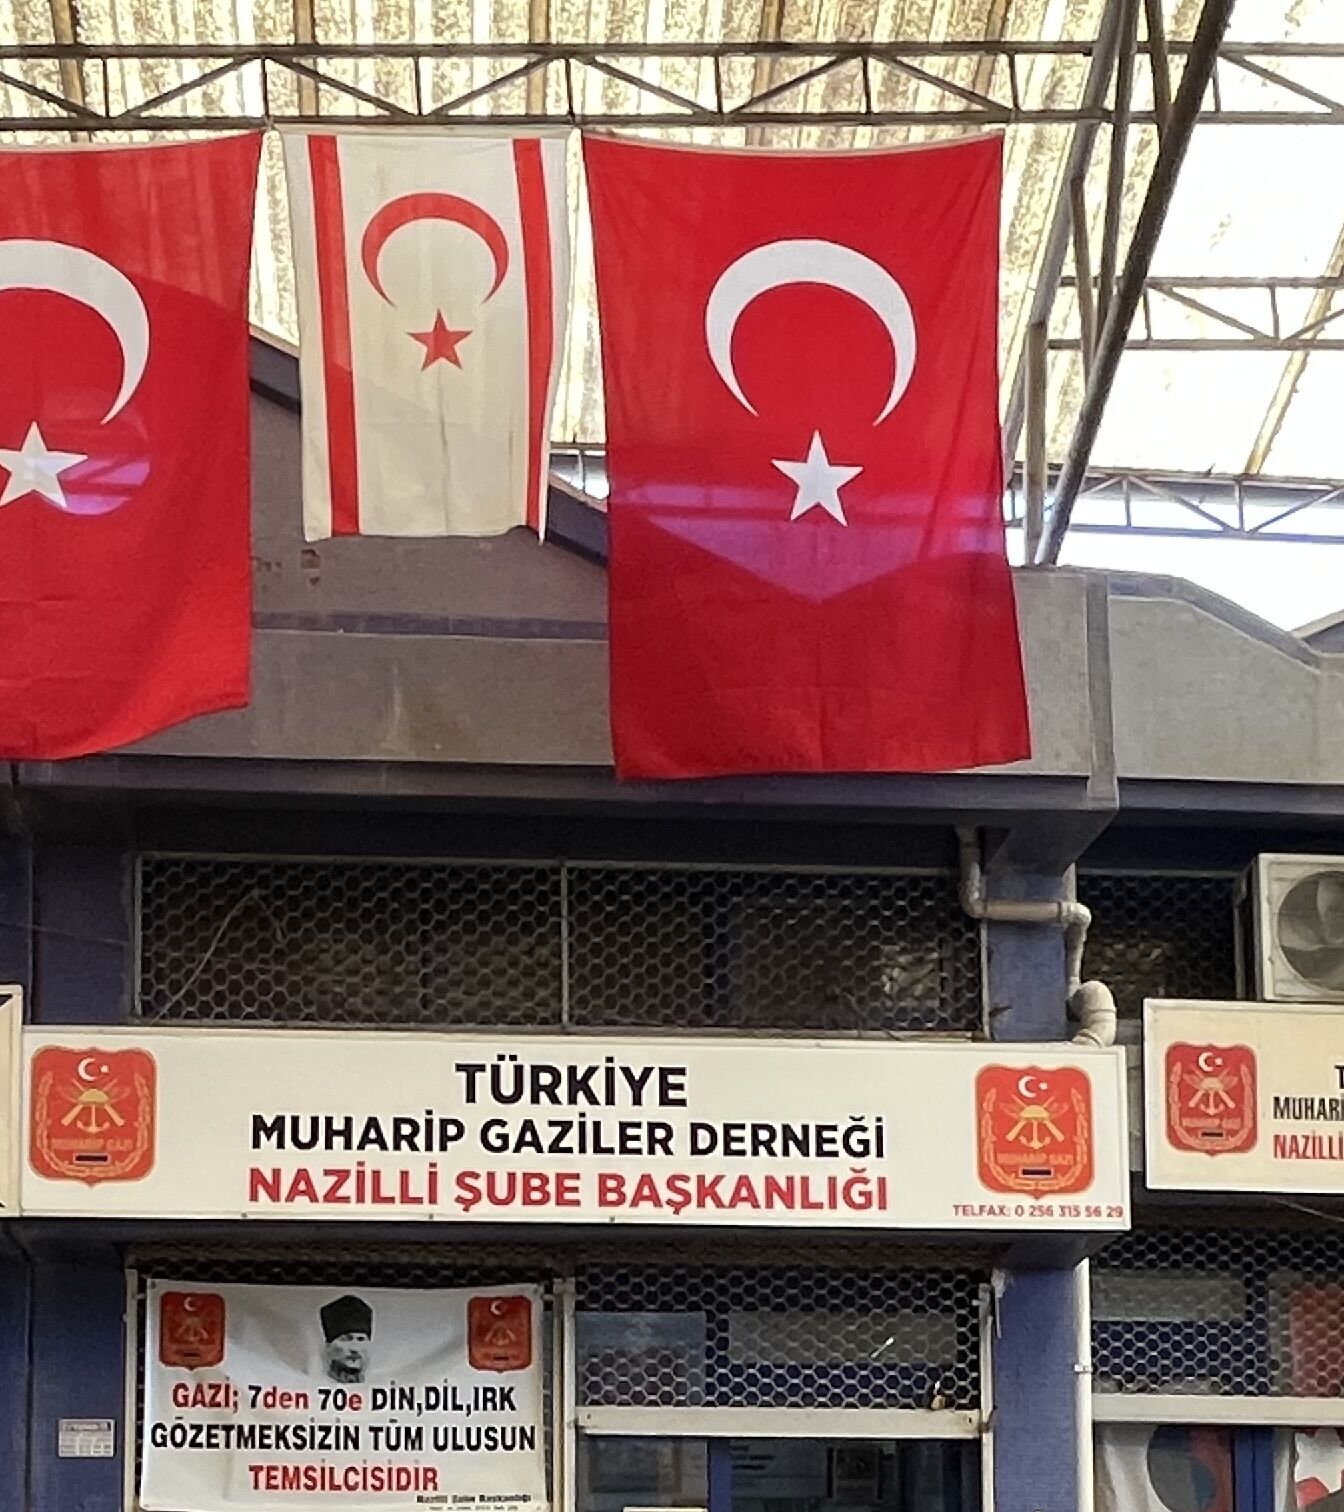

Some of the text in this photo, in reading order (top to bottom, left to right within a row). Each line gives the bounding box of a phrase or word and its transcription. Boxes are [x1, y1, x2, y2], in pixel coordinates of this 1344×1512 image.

[455, 1053, 688, 1107] TÜRKİYE
[251, 1108, 885, 1159] MUHARİP GAZİLER DERNEĞİ
[1273, 1130, 1344, 1161] NAZİLLİ
[249, 1161, 887, 1216] NAZİLLİ ŞUBE BAŞKANLIĞI
[1014, 1204, 1025, 1218] 0
[248, 1385, 309, 1410] 7den
[318, 1388, 362, 1411] 70e
[150, 1416, 360, 1451] GÖZETMEKSİZİN
[369, 1419, 424, 1451] TÜM
[432, 1425, 536, 1452] ULUSUN
